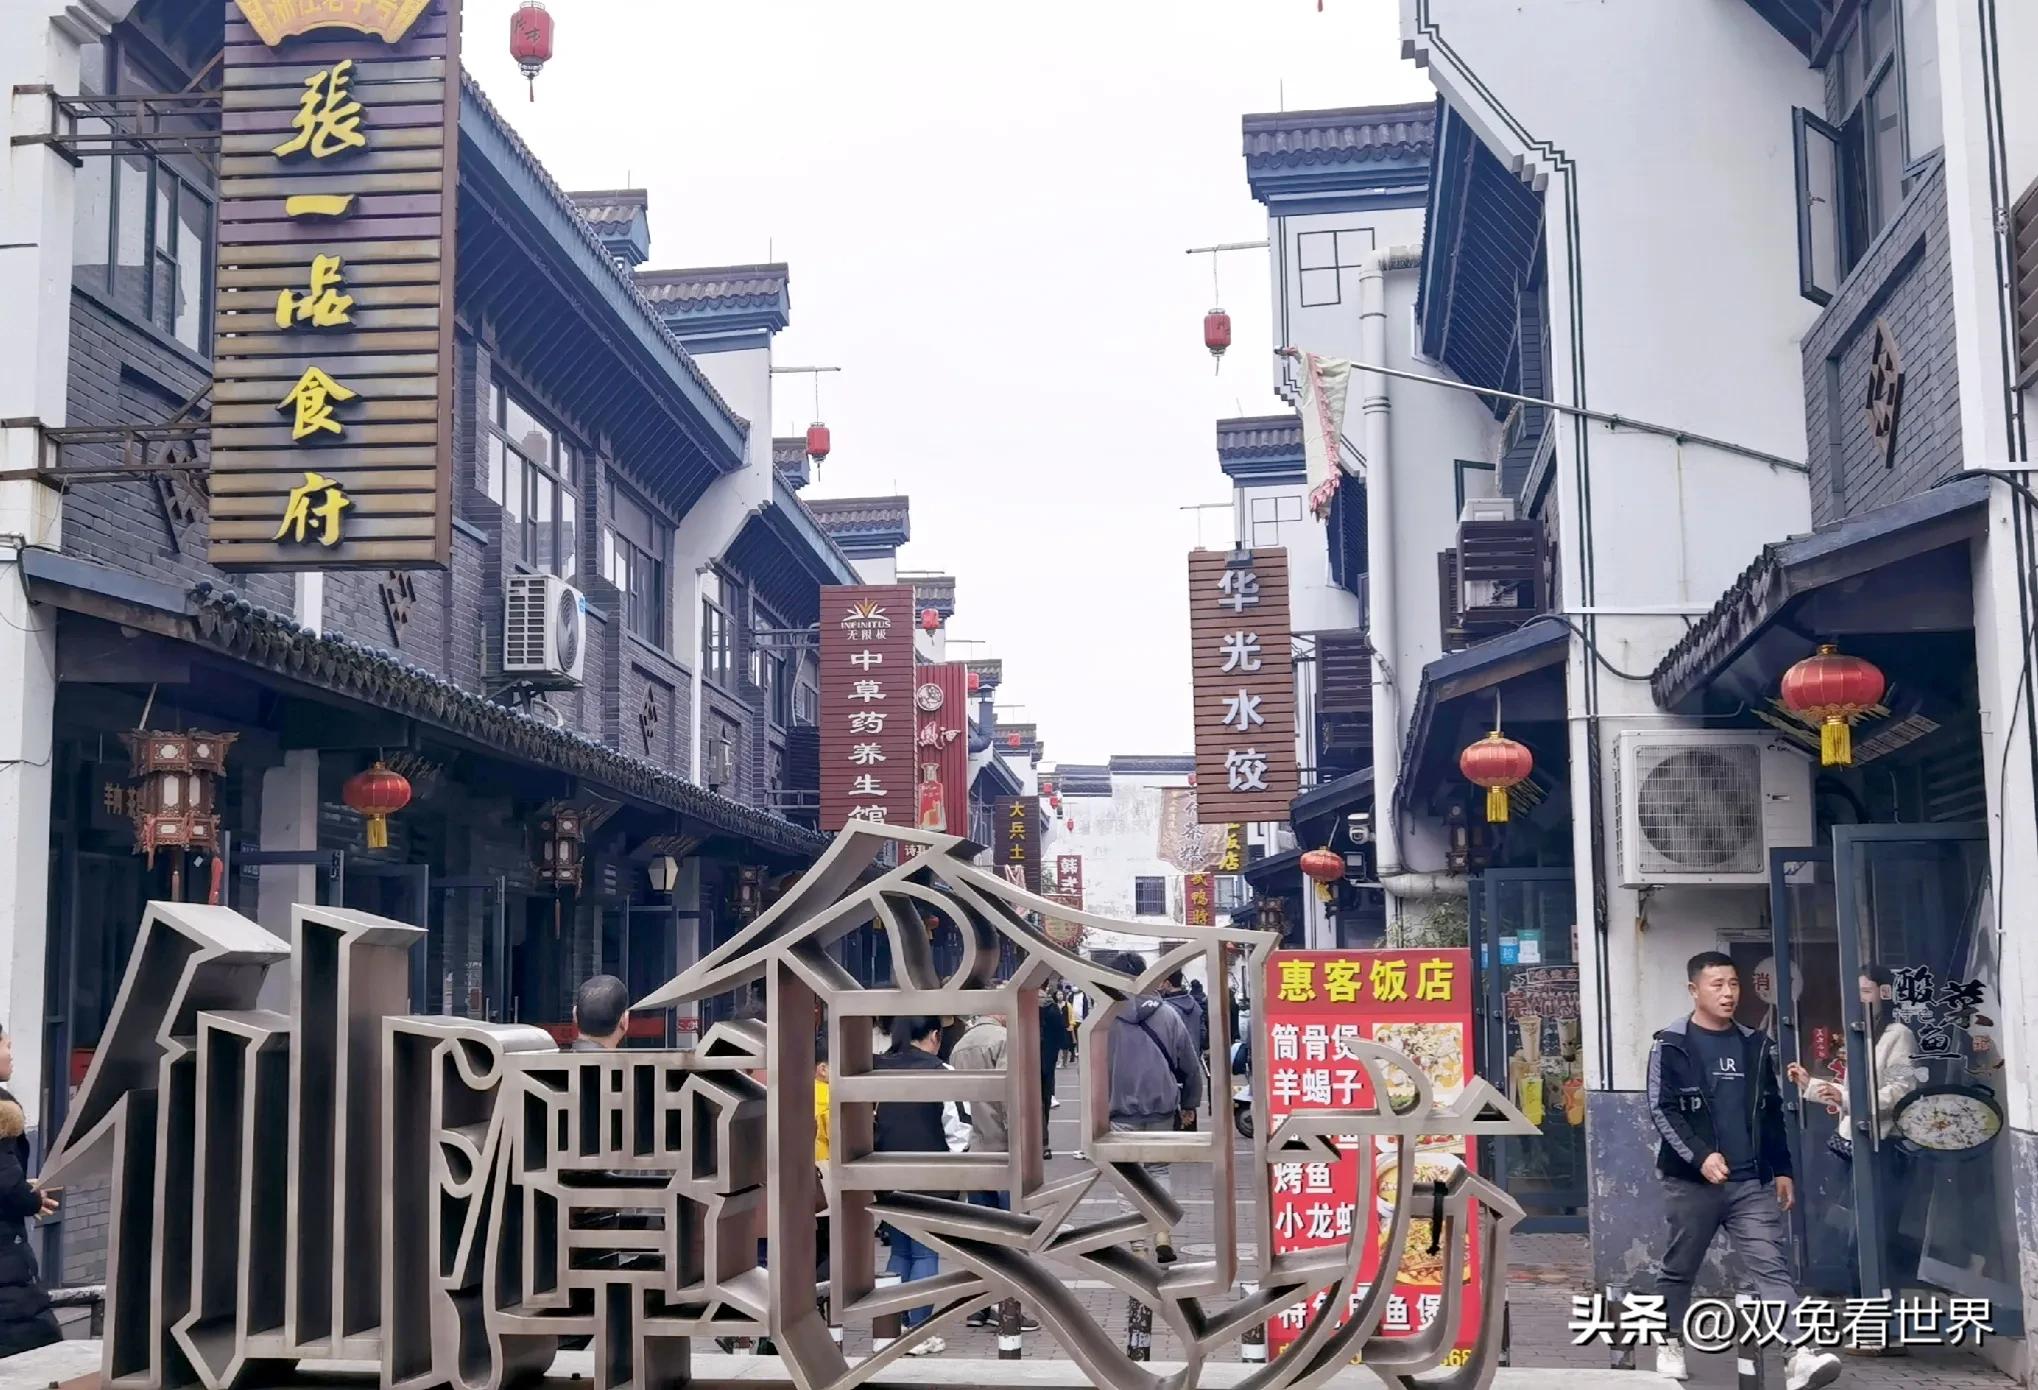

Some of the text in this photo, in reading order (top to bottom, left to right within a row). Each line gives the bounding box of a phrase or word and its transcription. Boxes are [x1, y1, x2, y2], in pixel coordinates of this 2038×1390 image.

[841, 620, 892, 629] INFINITUS
[1217, 567, 1269, 793] 华光水饺
[847, 649, 888, 824] 中草药养生馆
[1277, 957, 1456, 1003] 惠客饭店
[1271, 1023, 1359, 1061] 筒骨煲
[1272, 1068, 1362, 1105] 羊蝎子
[1274, 1162, 1333, 1194] 烤鱼
